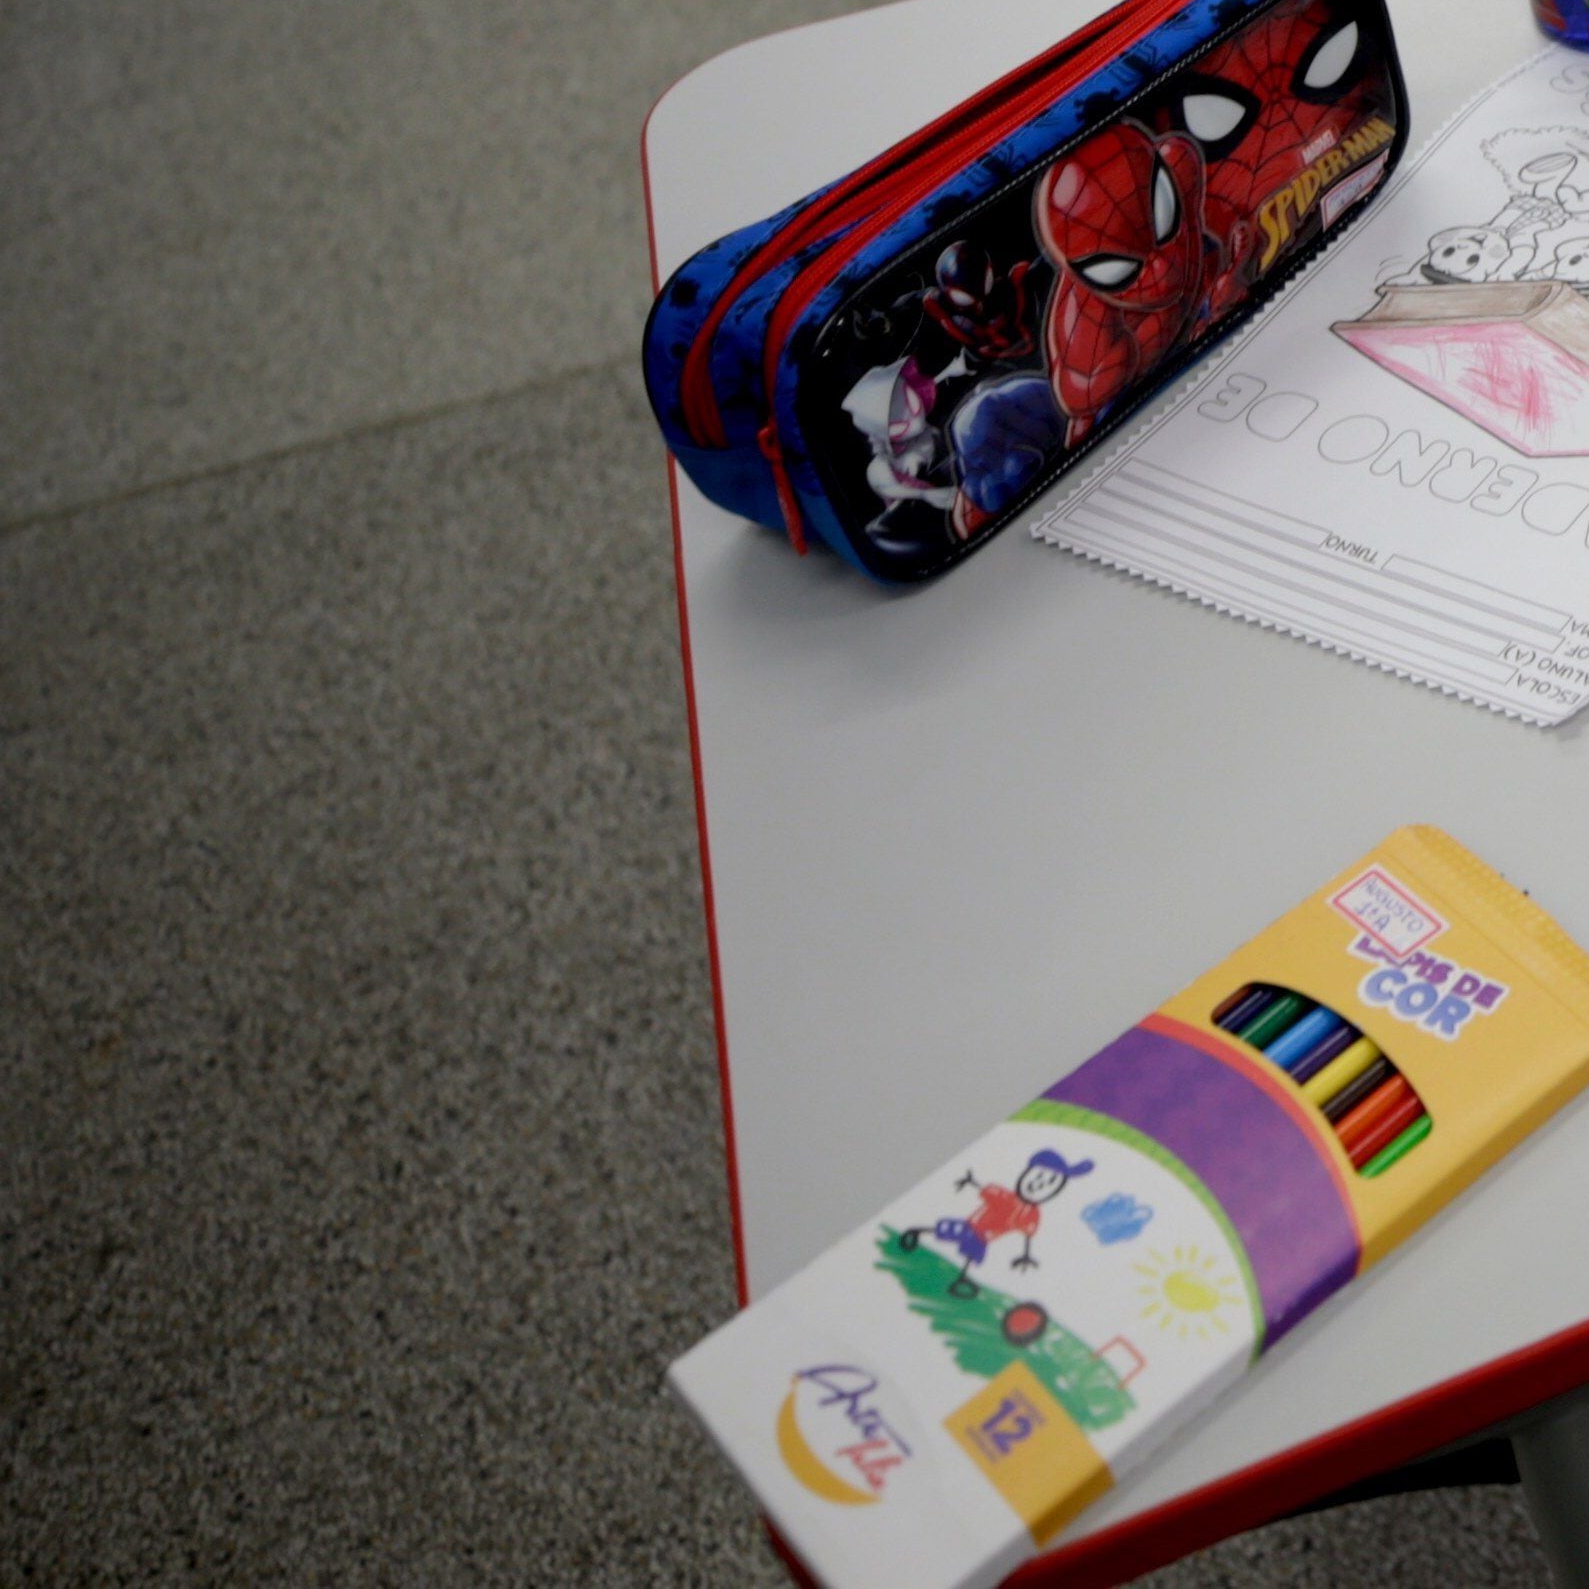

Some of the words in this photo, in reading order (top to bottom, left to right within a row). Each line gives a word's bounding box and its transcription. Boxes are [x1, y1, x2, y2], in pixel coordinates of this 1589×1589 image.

[1259, 117, 1396, 273] SPIDER-MAN
[1196, 371, 1319, 443] DE
[1324, 532, 1378, 565] TURNO
[1504, 644, 1537, 667] (A)
[1517, 673, 1582, 706] ESCOLA
[1364, 967, 1472, 1036] COR
[1451, 971, 1504, 1009] DE
[981, 1398, 1034, 1456] 12
